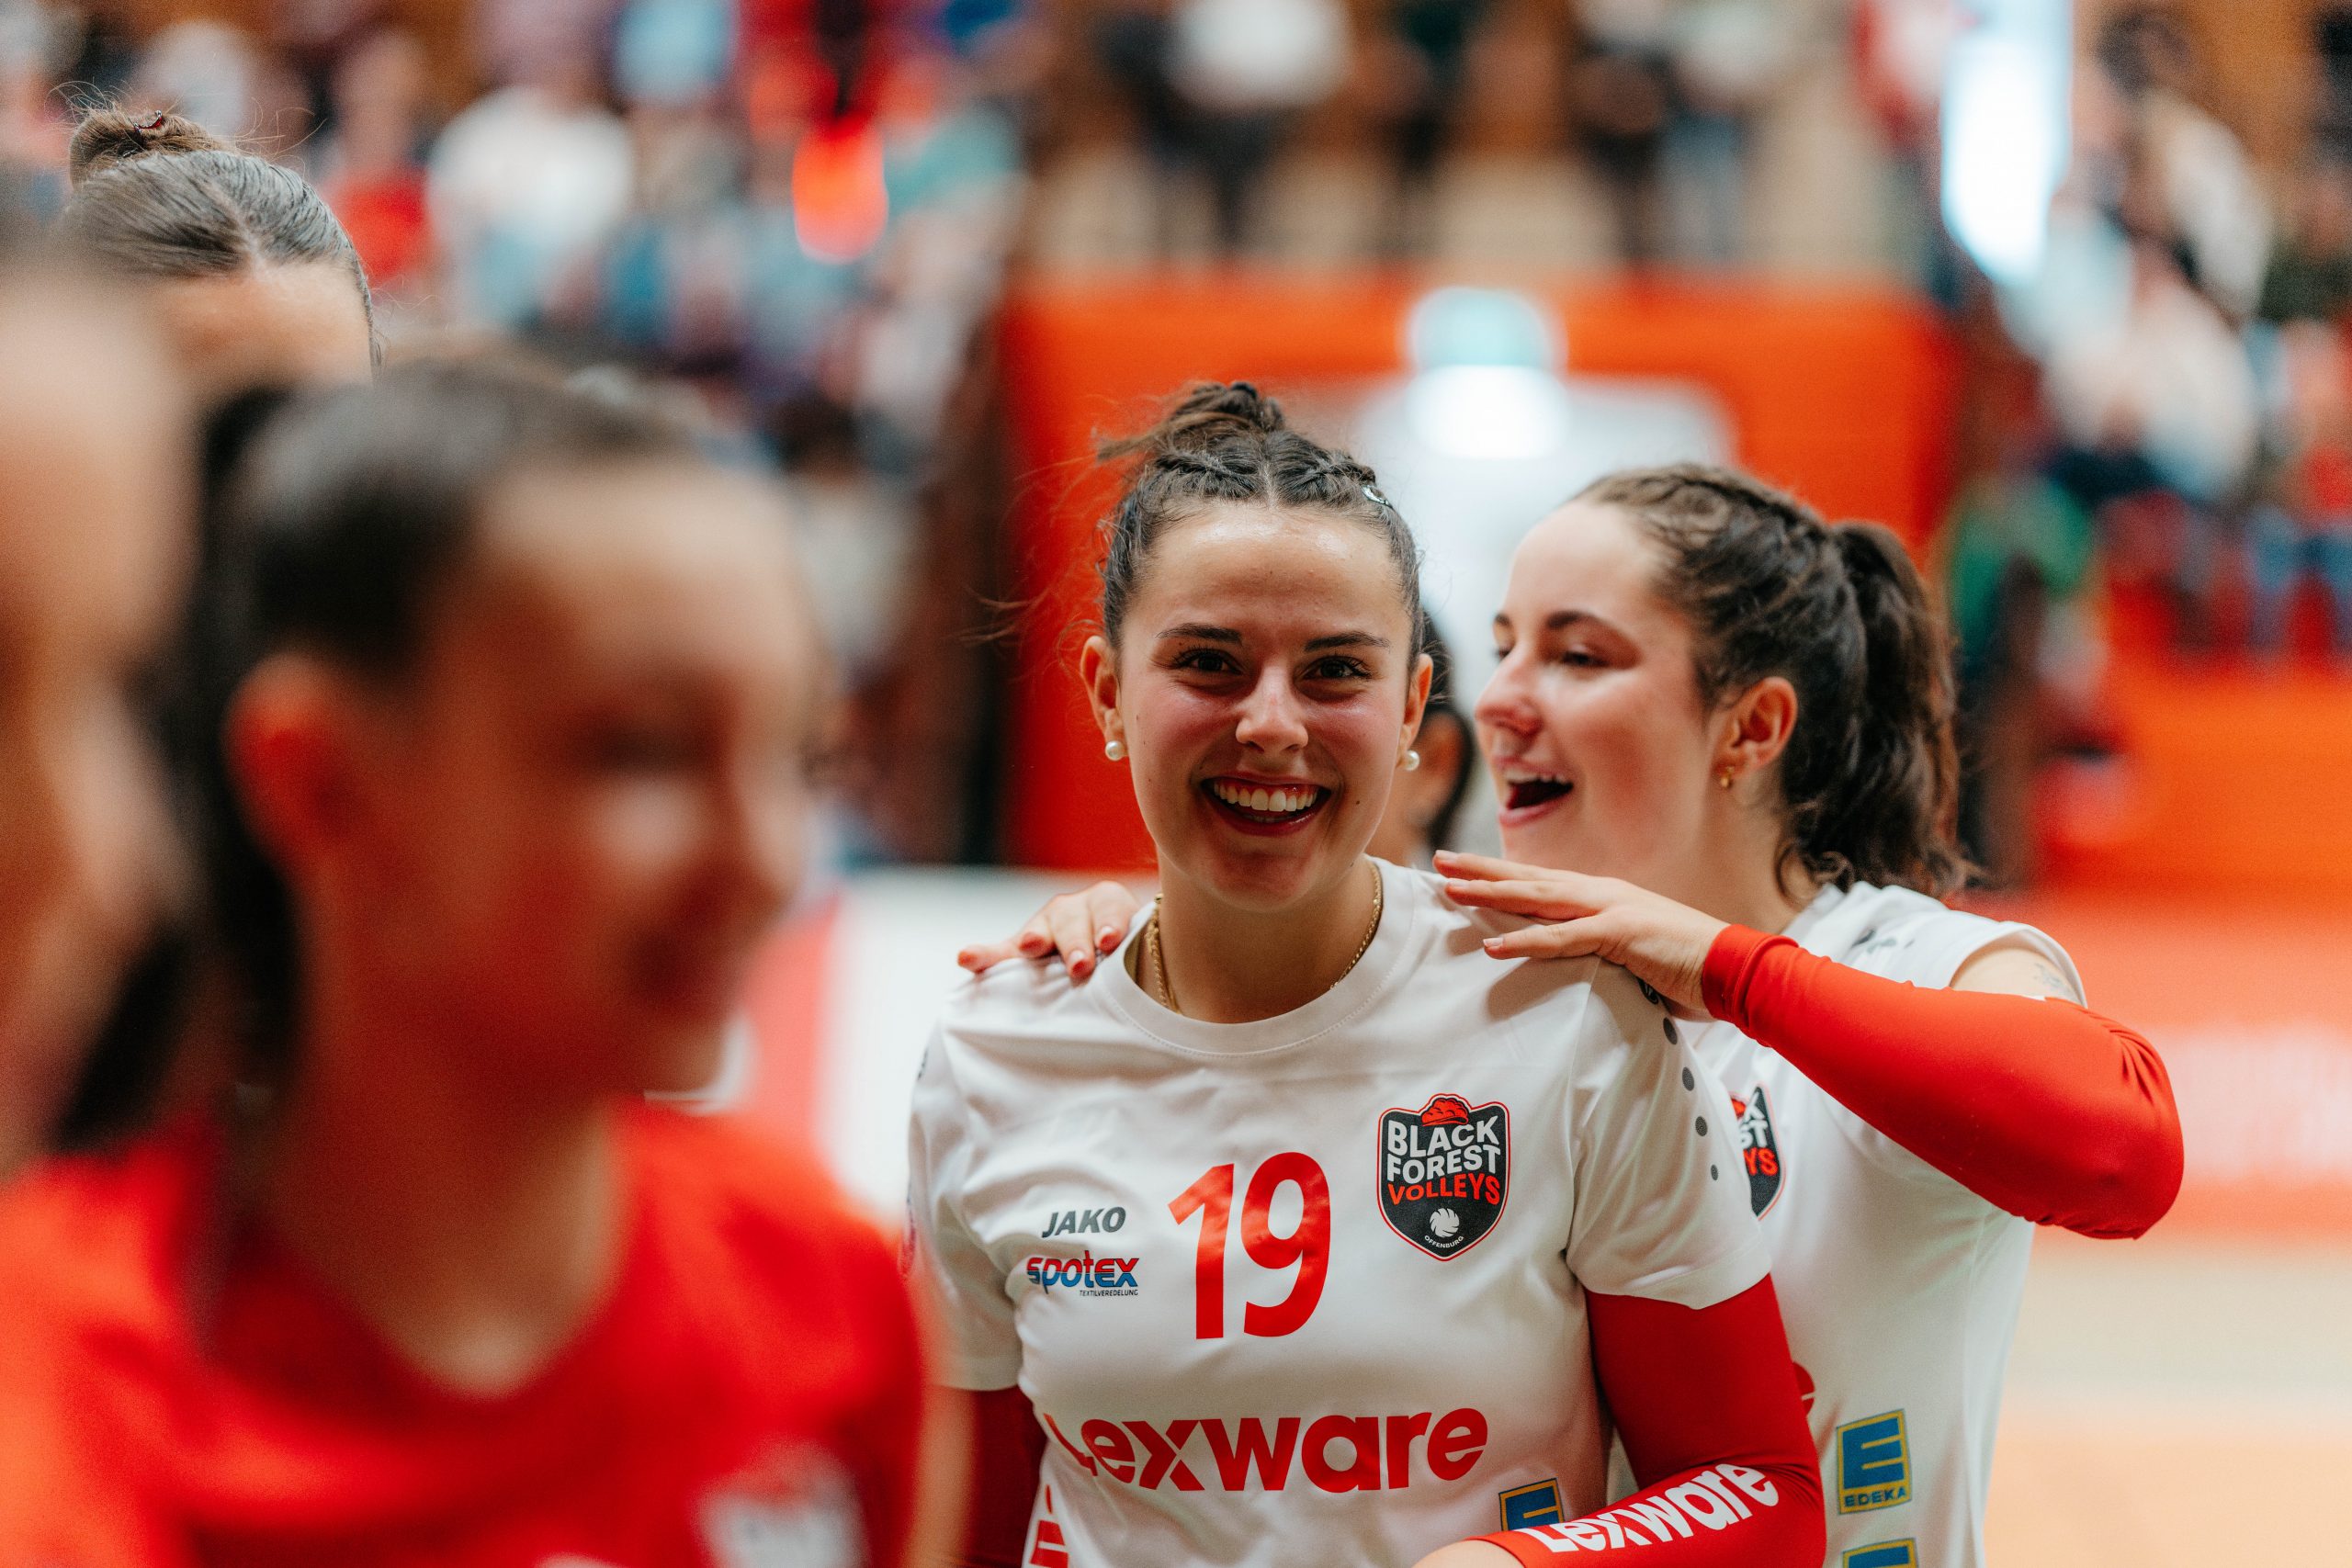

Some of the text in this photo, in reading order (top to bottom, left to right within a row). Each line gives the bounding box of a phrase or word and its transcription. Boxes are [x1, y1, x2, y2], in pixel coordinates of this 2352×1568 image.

[1387, 1115, 1499, 1157] BLACK
[1386, 1145, 1500, 1184] FOREST
[1387, 1173, 1500, 1205] VOLLEYS
[1042, 1206, 1126, 1238] JAKO
[1424, 1235, 1464, 1248] OFFENBURG
[1168, 1152, 1330, 1339] 19
[1044, 1407, 1488, 1494] Lexware
[1514, 1463, 1780, 1553] Lexware
[1845, 1486, 1906, 1507] EDEKA
